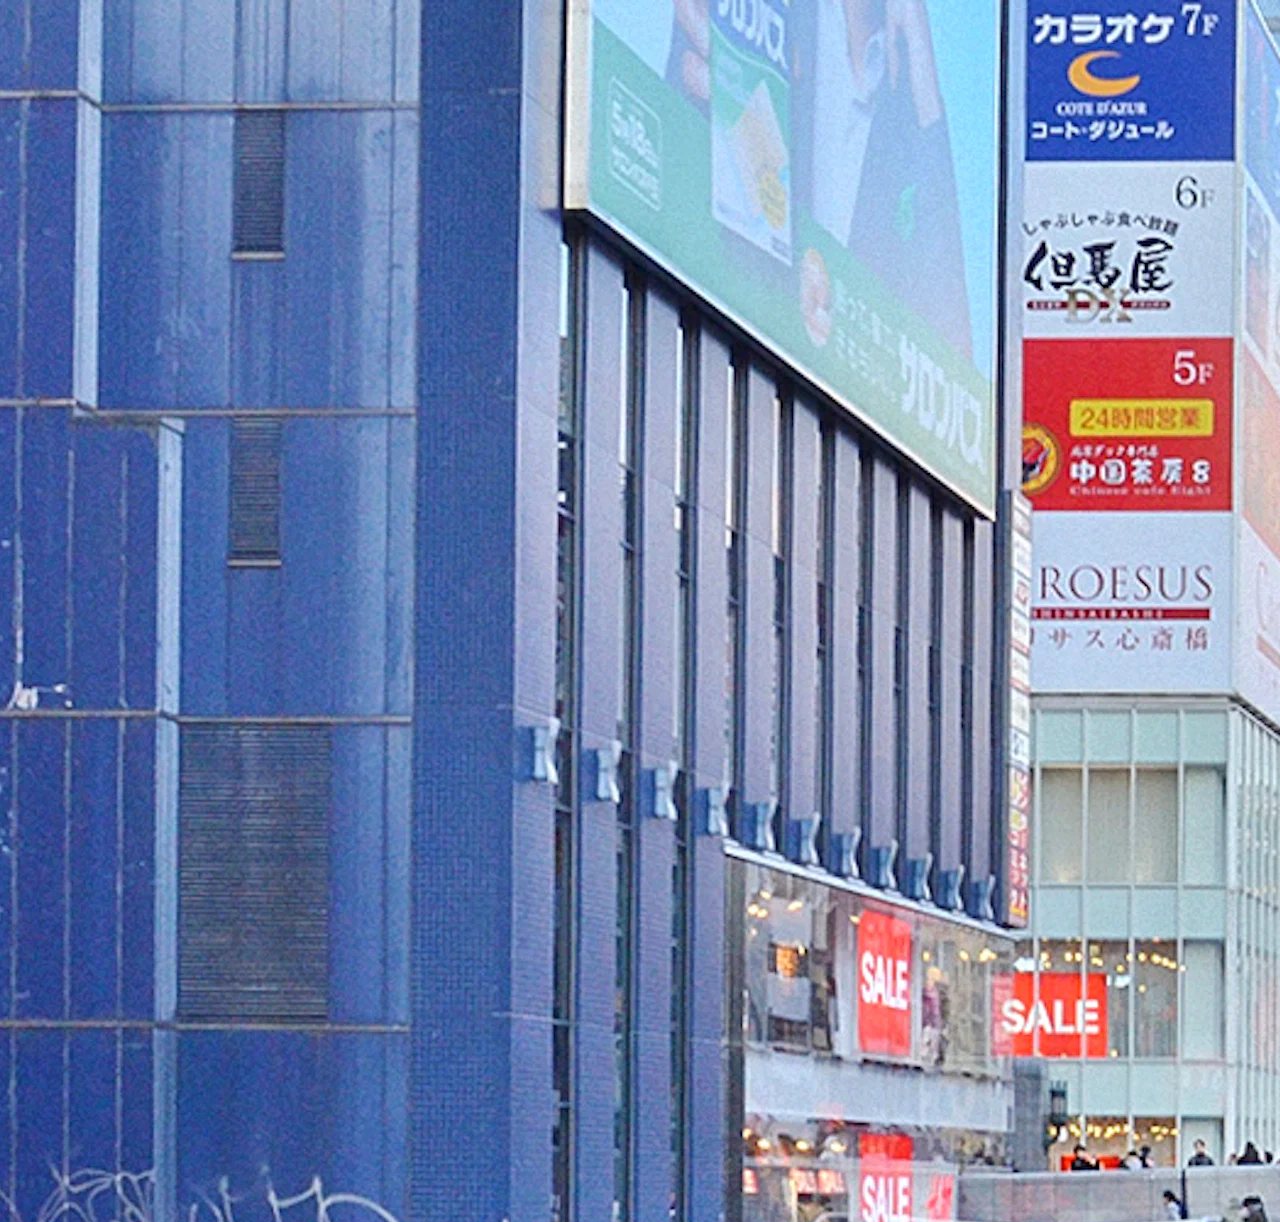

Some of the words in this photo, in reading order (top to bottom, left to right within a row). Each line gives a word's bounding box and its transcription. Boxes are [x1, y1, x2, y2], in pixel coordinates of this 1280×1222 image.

[1033, 13, 1175, 44] カラオケ
[1181, 4, 1218, 36] 7F
[1031, 122, 1175, 141] コート・ダジュール
[1175, 175, 1214, 209] 6F
[1022, 211, 1180, 237] しゃぶしゃぶ食べ放題
[1024, 238, 1175, 293] 但馬屋
[1064, 288, 1134, 323] DX
[1173, 350, 1215, 386] 5F
[1081, 406, 1200, 431] 24時間営業
[1070, 485, 1129, 496] Chinese
[861, 951, 910, 1010] SALE
[1001, 997, 1100, 1034] SALE
